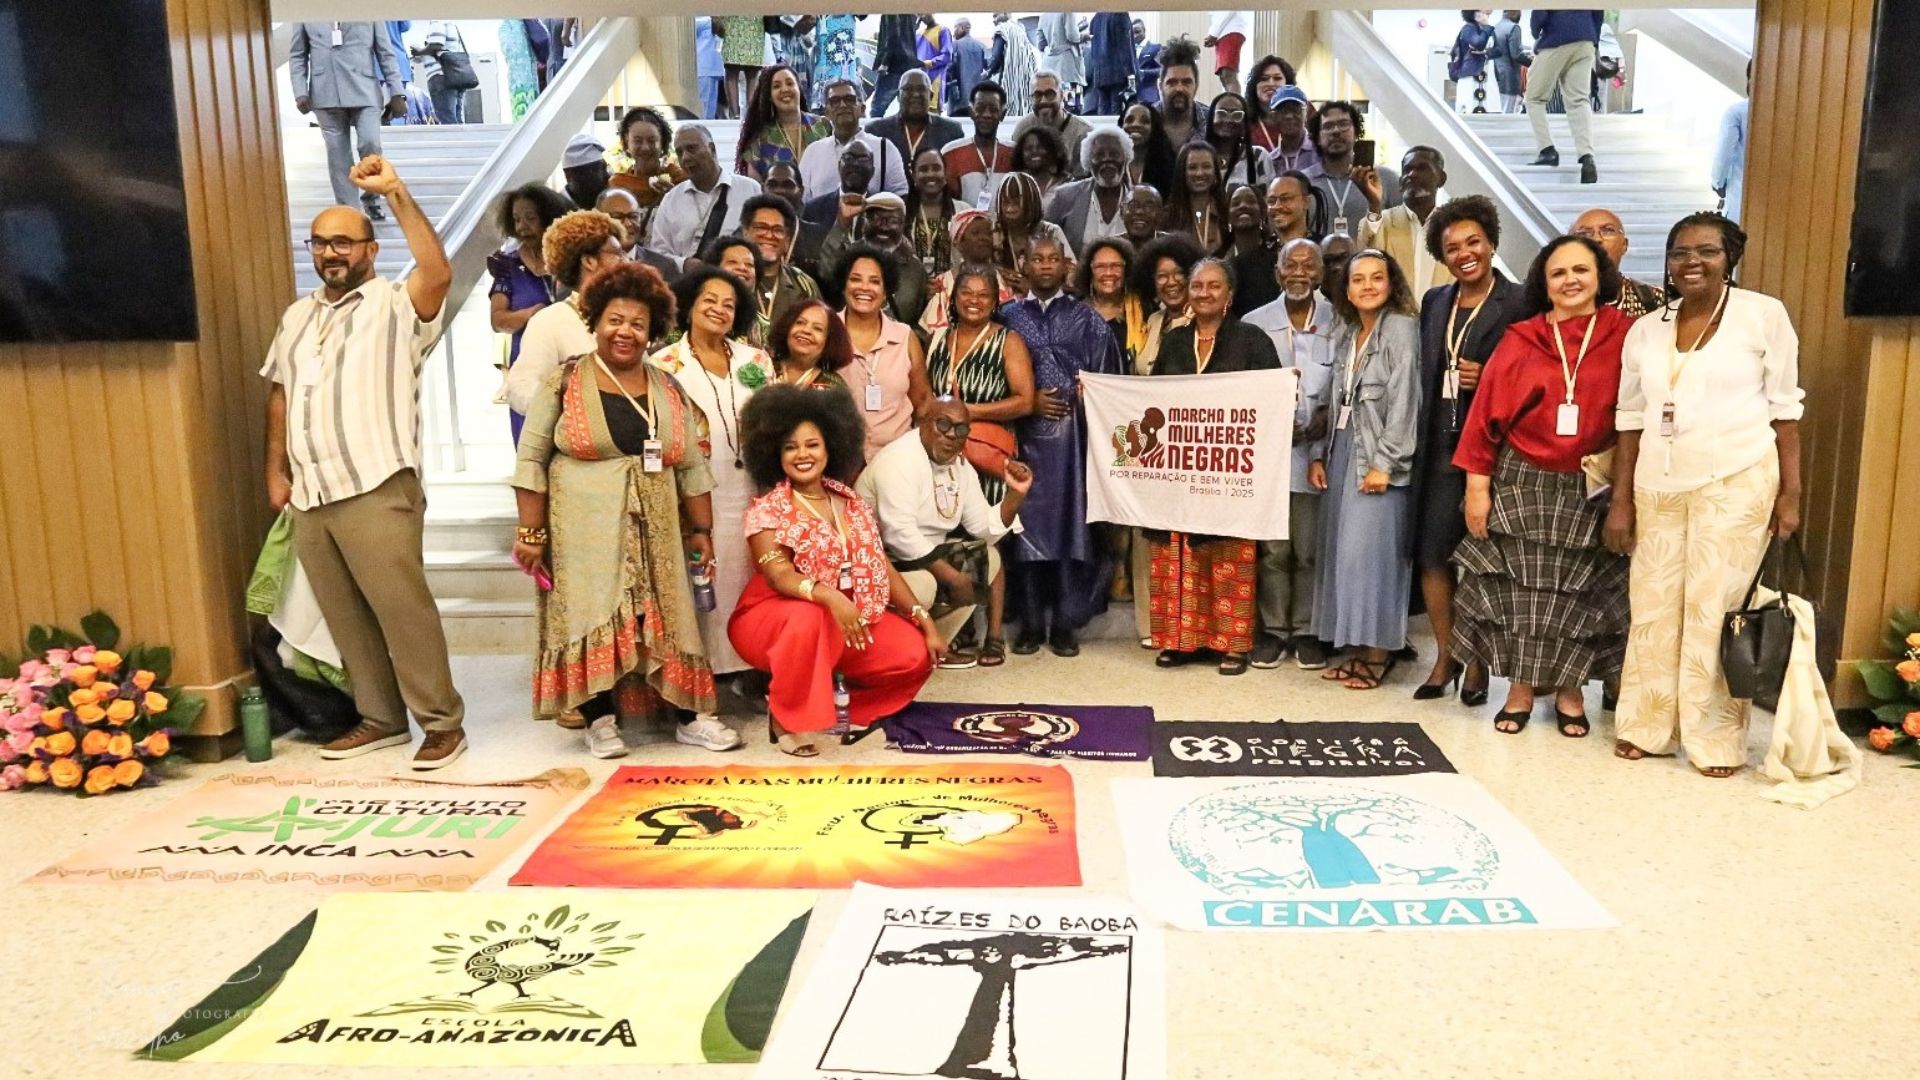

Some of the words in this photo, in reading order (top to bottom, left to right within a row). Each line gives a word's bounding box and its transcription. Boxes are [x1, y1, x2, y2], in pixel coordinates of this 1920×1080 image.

[1168, 407, 1224, 423] MARCHA
[1230, 408, 1257, 424] DAS
[1168, 425, 1256, 446] MULHERES
[1167, 445, 1255, 474] NEGRAS
[1110, 470, 1130, 479] POR
[1132, 472, 1187, 484] REPARAÇÃO
[1191, 475, 1197, 483] E
[1200, 476, 1220, 485] BEM
[1224, 478, 1253, 487] VIVER
[1231, 487, 1254, 498] 2025
[1250, 744, 1422, 758] NEGRA
[738, 777, 791, 786] DAS
[936, 776, 1043, 785] NEGRAS
[313, 805, 527, 817] CULTURAL
[255, 844, 358, 858] INCA
[883, 905, 991, 928] RAÍZES
[1009, 914, 1041, 930] DO
[1213, 899, 1523, 925] CENARAB
[421, 1017, 526, 1027] ESCOLA
